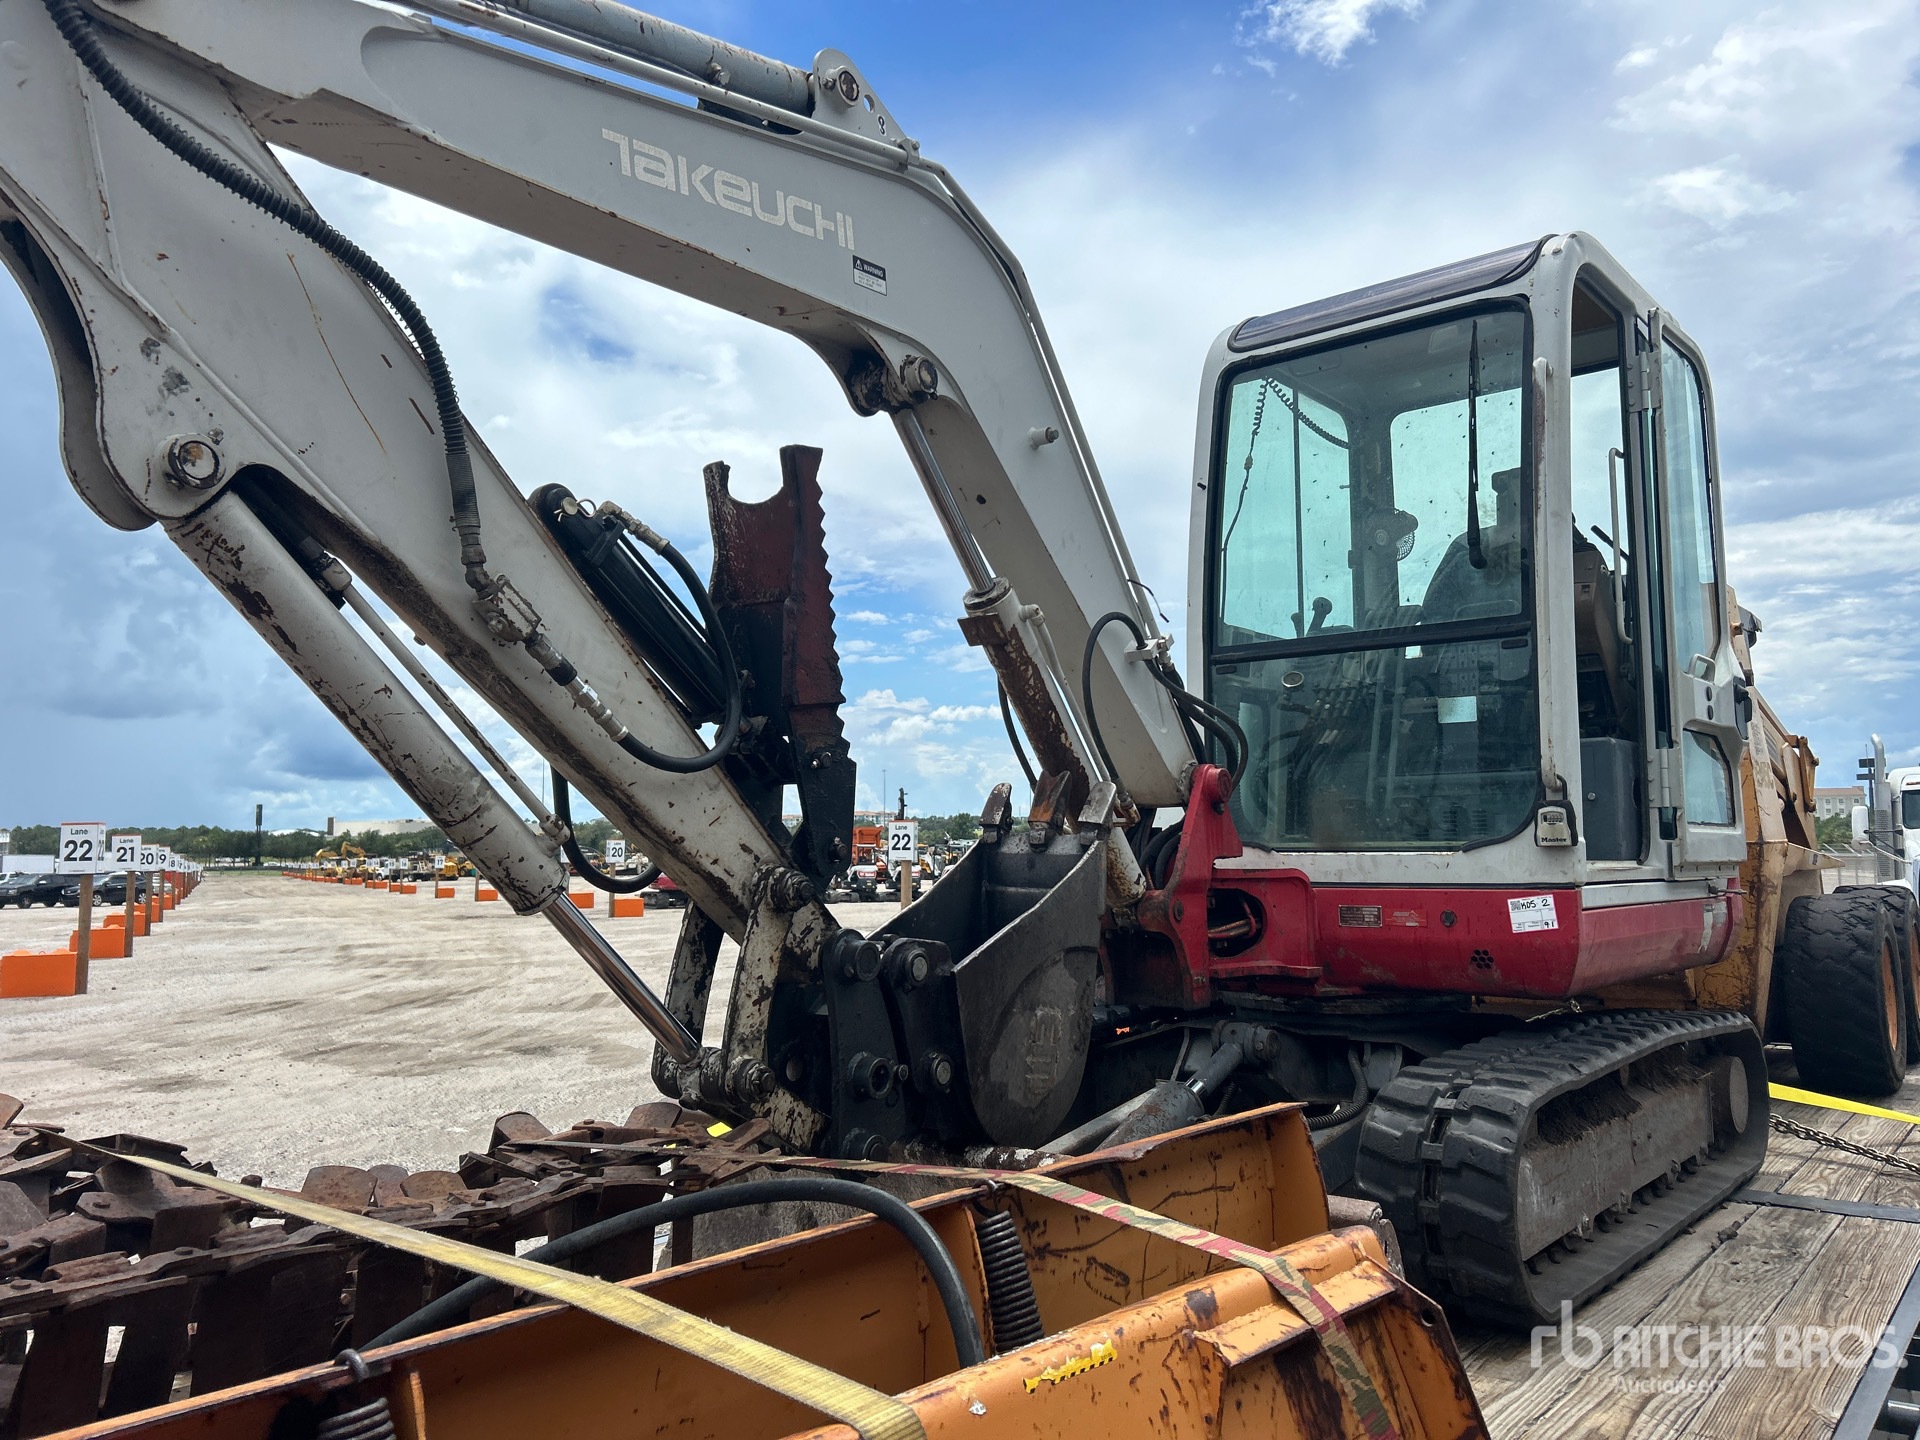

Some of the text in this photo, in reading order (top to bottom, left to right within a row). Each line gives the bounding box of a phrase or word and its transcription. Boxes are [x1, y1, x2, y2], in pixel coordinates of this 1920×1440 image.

[601, 127, 856, 251] TAKEUCHI
[70, 828, 89, 836] Lane
[891, 833, 911, 850] 22
[63, 839, 93, 862] 22
[116, 846, 135, 862] 21
[611, 847, 623, 857] 20
[140, 853, 154, 865] 20
[159, 853, 167, 865] 9
[170, 859, 176, 868] 8
[1541, 898, 1551, 907] 2
